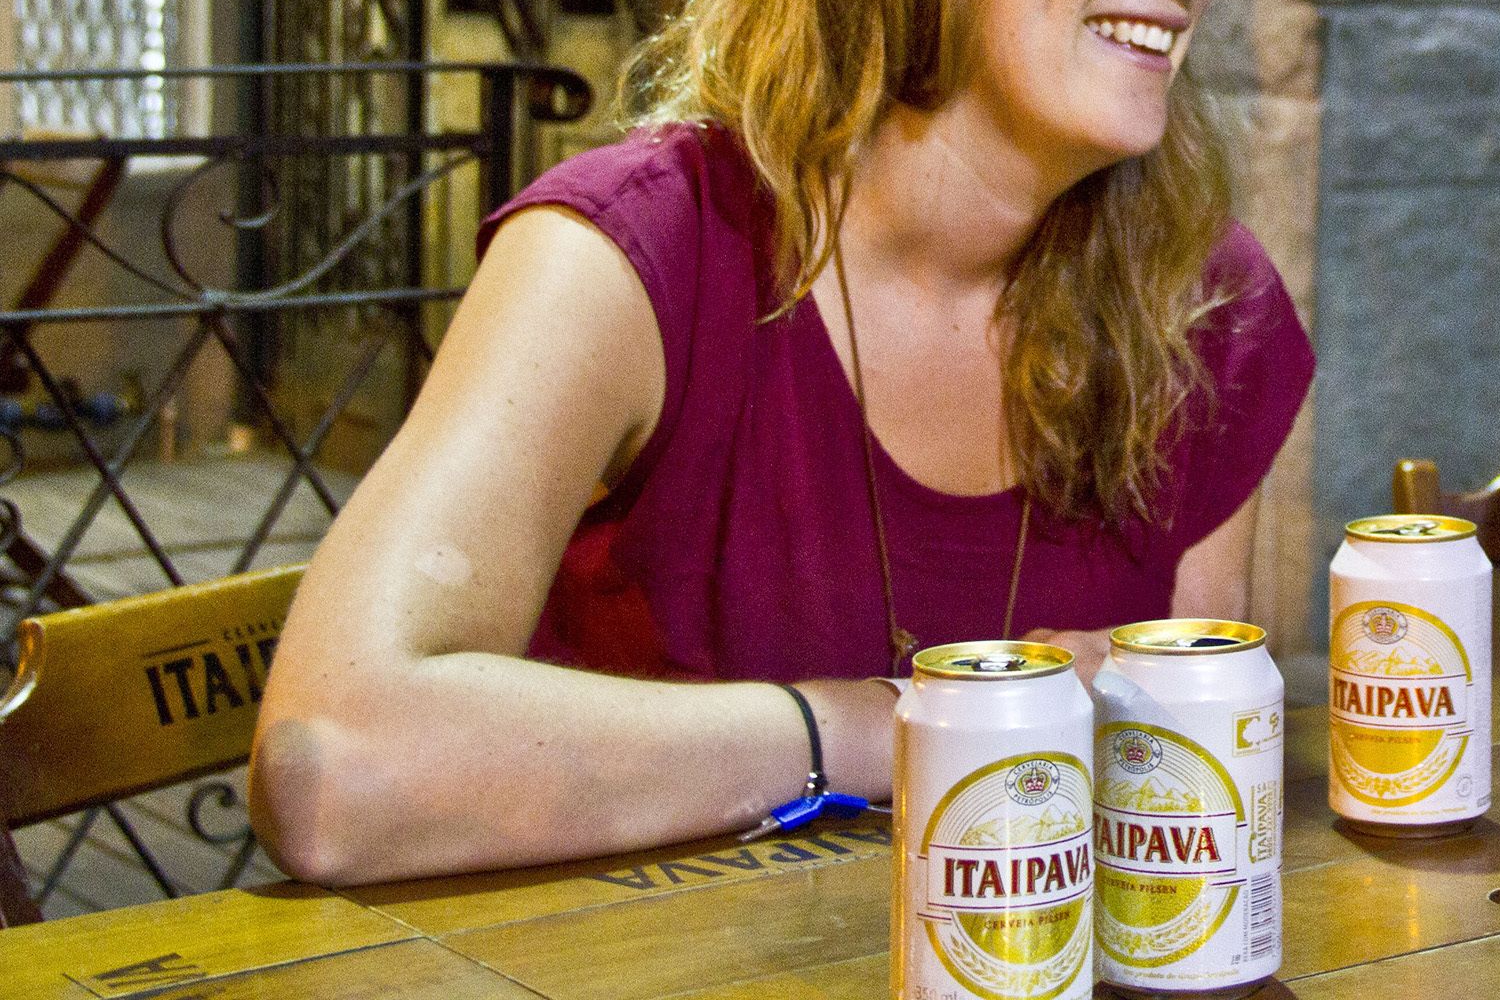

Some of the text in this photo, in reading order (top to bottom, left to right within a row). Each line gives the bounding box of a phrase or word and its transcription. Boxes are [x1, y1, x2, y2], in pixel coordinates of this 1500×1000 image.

[145, 637, 279, 727] ITAI
[1333, 677, 1456, 718] ITAIPAVA
[591, 826, 892, 890] AIPAVA
[1093, 812, 1222, 865] TAIPAVA
[943, 843, 1091, 899] ITAIPAVA
